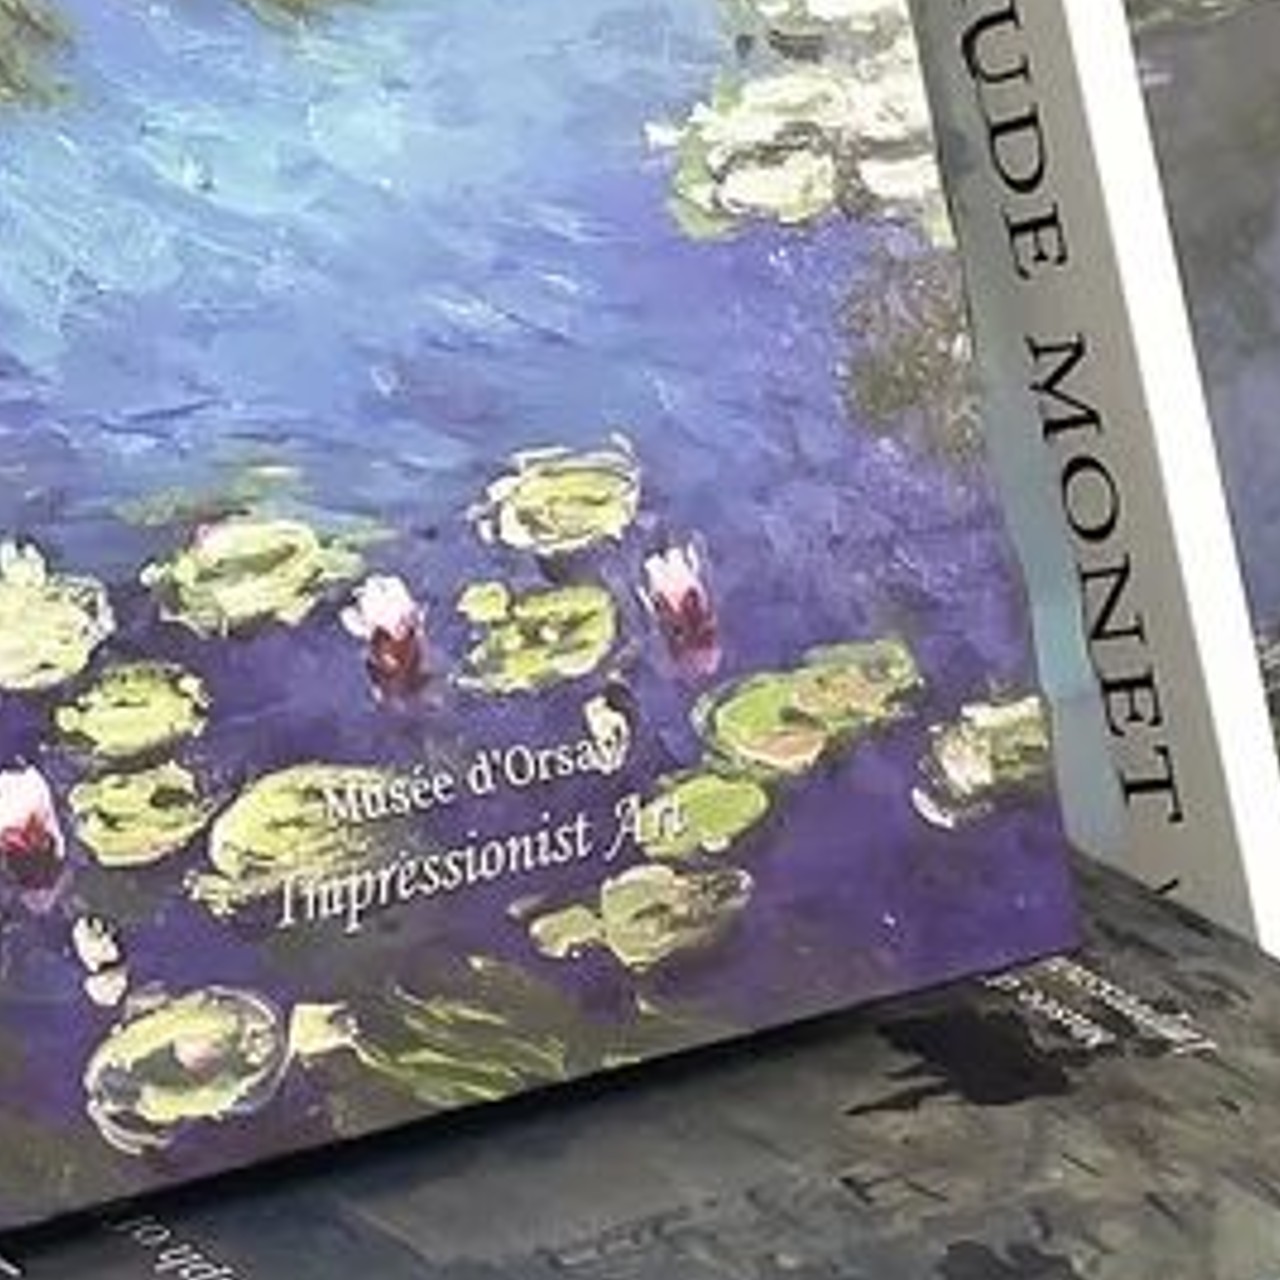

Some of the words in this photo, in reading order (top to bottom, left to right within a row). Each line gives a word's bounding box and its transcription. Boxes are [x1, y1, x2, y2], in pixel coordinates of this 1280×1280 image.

[1025, 330, 1185, 825] MONET
[276, 806, 591, 931] Impressionist
[604, 793, 686, 861] Art
[320, 764, 456, 828] Musée
